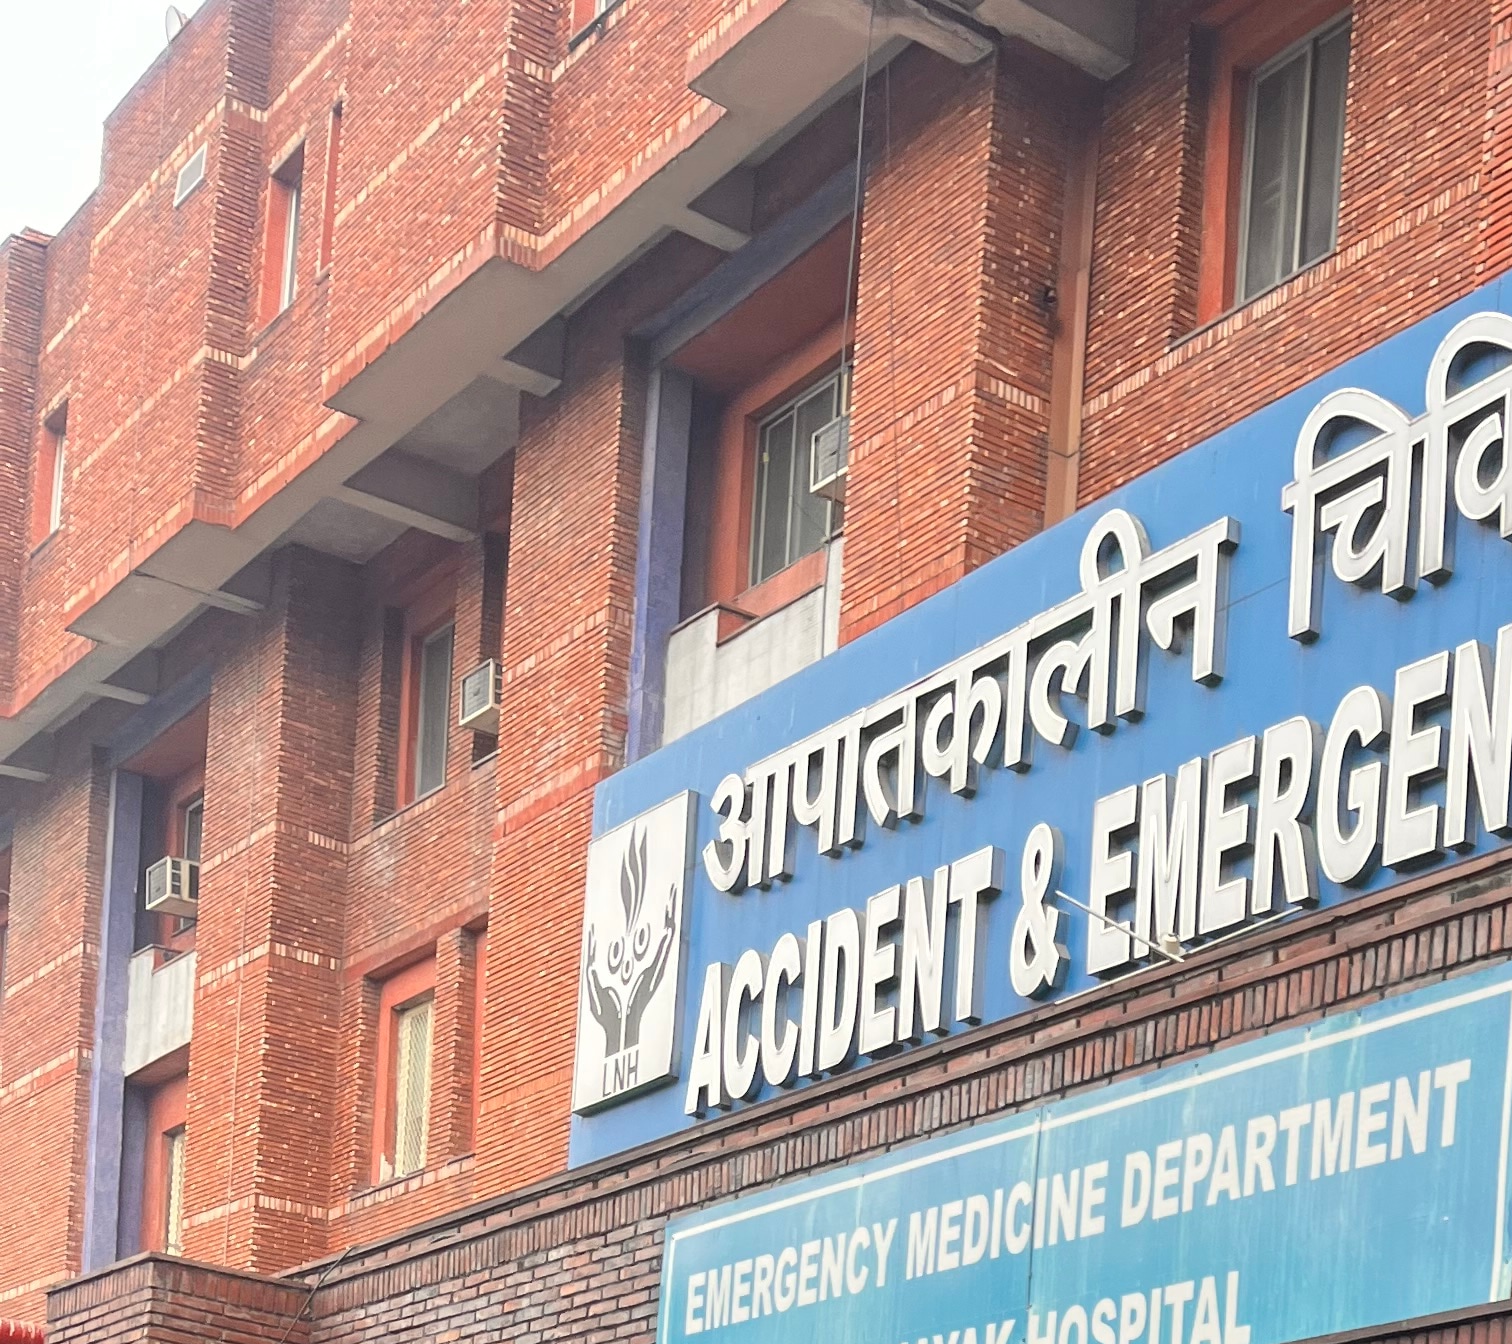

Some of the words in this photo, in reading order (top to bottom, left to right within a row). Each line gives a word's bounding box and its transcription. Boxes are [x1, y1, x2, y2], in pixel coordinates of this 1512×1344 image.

[702, 508, 1240, 895] आपातकालीन
[602, 1049, 639, 1097] LNH
[685, 846, 1005, 1119] ACCIDENT
[1010, 822, 1070, 1000] &
[685, 1217, 897, 1336] EMERGENCY
[906, 1159, 1109, 1281] MEDICINE
[1120, 1058, 1472, 1228] DEPARTMENT
